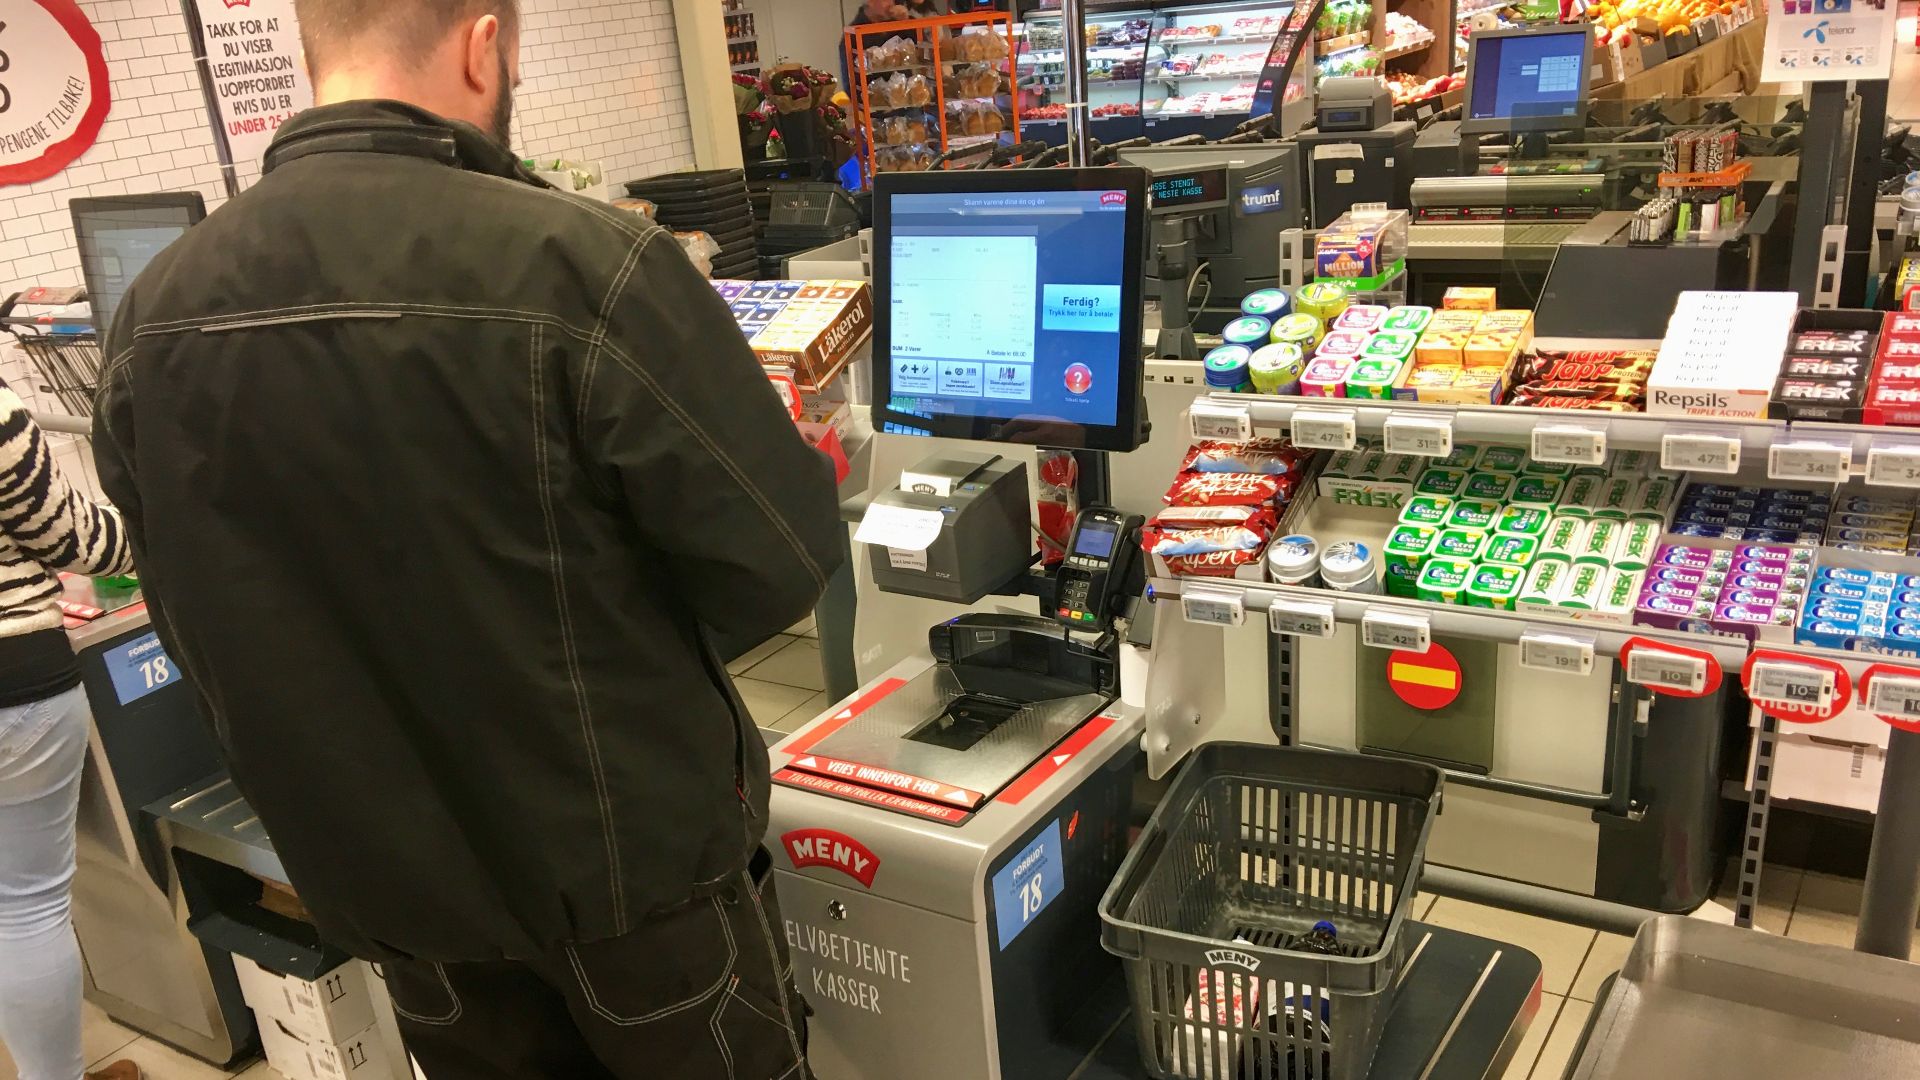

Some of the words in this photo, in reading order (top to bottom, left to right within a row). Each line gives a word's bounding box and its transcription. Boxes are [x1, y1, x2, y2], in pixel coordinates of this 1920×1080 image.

[206, 21, 238, 38] TAKK
[240, 19, 263, 35] FOR
[266, 17, 279, 32] AT
[1828, 26, 1856, 36] telenor
[223, 42, 240, 57] DU
[241, 38, 274, 55] VISER
[212, 55, 293, 78] LEGITIMASJON
[219, 74, 296, 98] UOPPFORDRET
[232, 98, 259, 116] HVIS
[260, 96, 276, 111] DU
[278, 94, 292, 108] ER
[0, 121, 51, 155] PENGENE
[46, 75, 86, 131] TILBAKE!
[228, 117, 267, 136] UNDER
[268, 114, 282, 130] 25
[1170, 178, 1195, 188] STENGT
[1102, 193, 1125, 203] MENY
[1158, 188, 1179, 199] NESTE
[1182, 186, 1203, 196] KASSE
[1242, 189, 1281, 206] trumf
[1324, 260, 1364, 273] MILLION
[1062, 296, 1100, 309] Ferdig?
[817, 298, 865, 363] Läkerol
[1795, 337, 1865, 352] FRISK
[761, 352, 797, 364] Läkerol
[1542, 358, 1615, 381] Japp
[1612, 370, 1643, 378] PROTEIN
[1788, 360, 1860, 376] FRISK
[1655, 390, 1728, 409] Repsils
[1781, 384, 1854, 400] FRISK
[1686, 407, 1716, 416] TRIPLE
[1719, 409, 1757, 418] ACTION
[1333, 485, 1403, 509] FRISK
[1414, 504, 1443, 515] Extra
[1459, 509, 1490, 519] Extra
[1398, 534, 1429, 545] Extra
[1551, 520, 1573, 550] FRISK
[1588, 522, 1610, 553] FRISK
[1627, 523, 1649, 558] FRISK
[1445, 538, 1476, 550] Extra
[1749, 548, 1787, 559] Extra
[1432, 568, 1464, 580] Extra
[1663, 569, 1699, 581] Extra
[1745, 561, 1783, 573] Extra
[1830, 568, 1869, 581] Extra
[1481, 574, 1513, 586] Extra
[1534, 562, 1558, 594] FRISK
[1572, 566, 1597, 599] FRISK
[1740, 575, 1779, 588] Extra
[1610, 572, 1635, 607] FRISK
[1656, 582, 1693, 596] Extra
[1824, 583, 1863, 596] Extra
[1651, 597, 1689, 611] Extra
[1735, 591, 1774, 604] Extra
[1729, 607, 1768, 620] Extra
[1817, 607, 1858, 620] Extra
[1816, 622, 1855, 635] Extra
[139, 655, 169, 689] 18
[827, 761, 854, 776] VEIES
[856, 764, 913, 788] INNENFOR
[914, 778, 940, 795] HER
[792, 837, 870, 873] MENY
[1012, 843, 1045, 880] FORBUDT
[1019, 872, 1043, 923] 18
[785, 919, 911, 983] ELVBETJENTE
[1209, 951, 1258, 967] MENY
[812, 967, 882, 1015] KASSER
